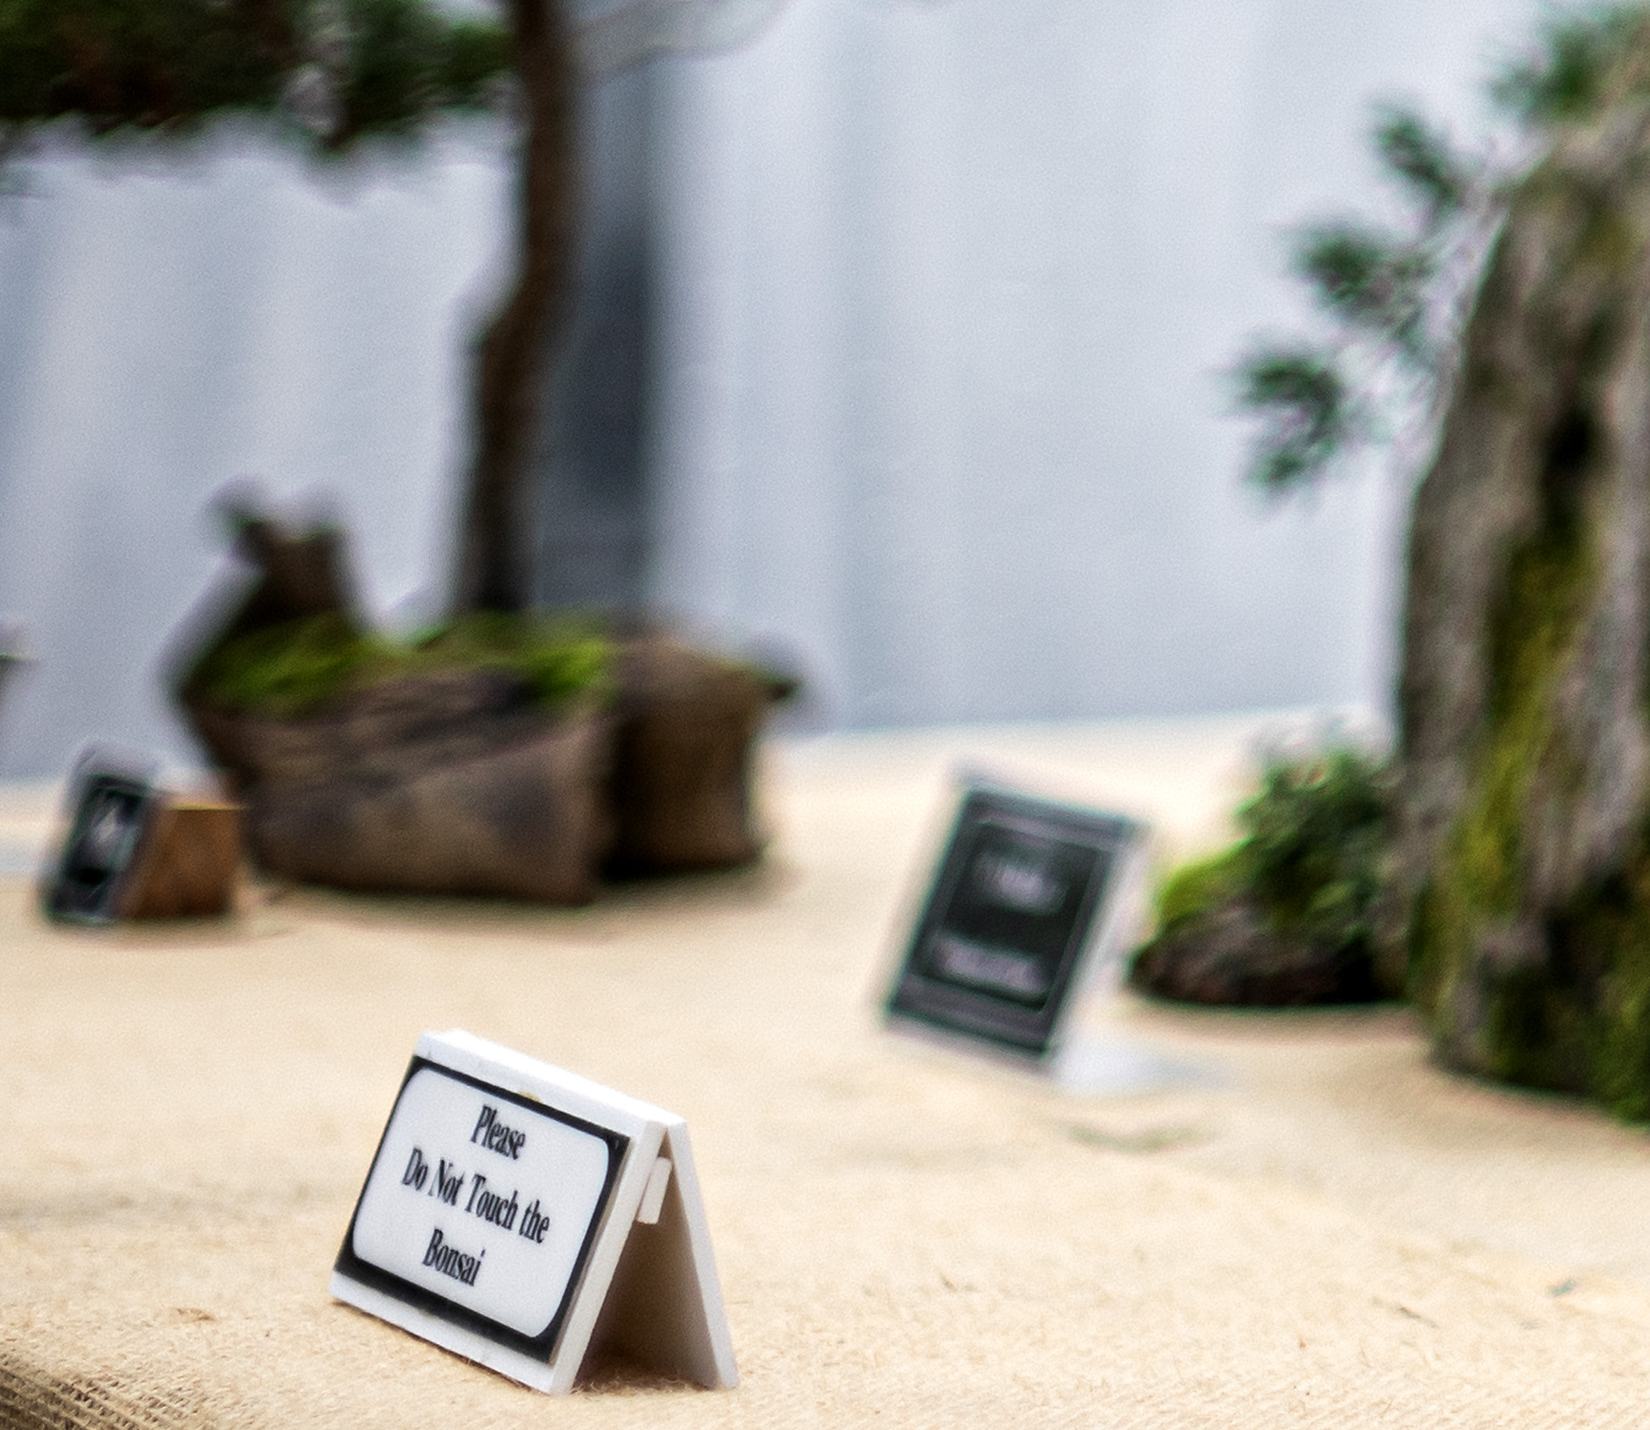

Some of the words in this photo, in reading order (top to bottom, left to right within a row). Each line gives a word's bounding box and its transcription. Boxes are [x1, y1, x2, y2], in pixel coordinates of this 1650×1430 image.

[470, 1104, 526, 1160] Please
[402, 1146, 429, 1190] Do
[428, 1157, 465, 1207] Not
[464, 1173, 519, 1231] Touch
[519, 1199, 550, 1243] the
[422, 1227, 485, 1286] Bonsai
